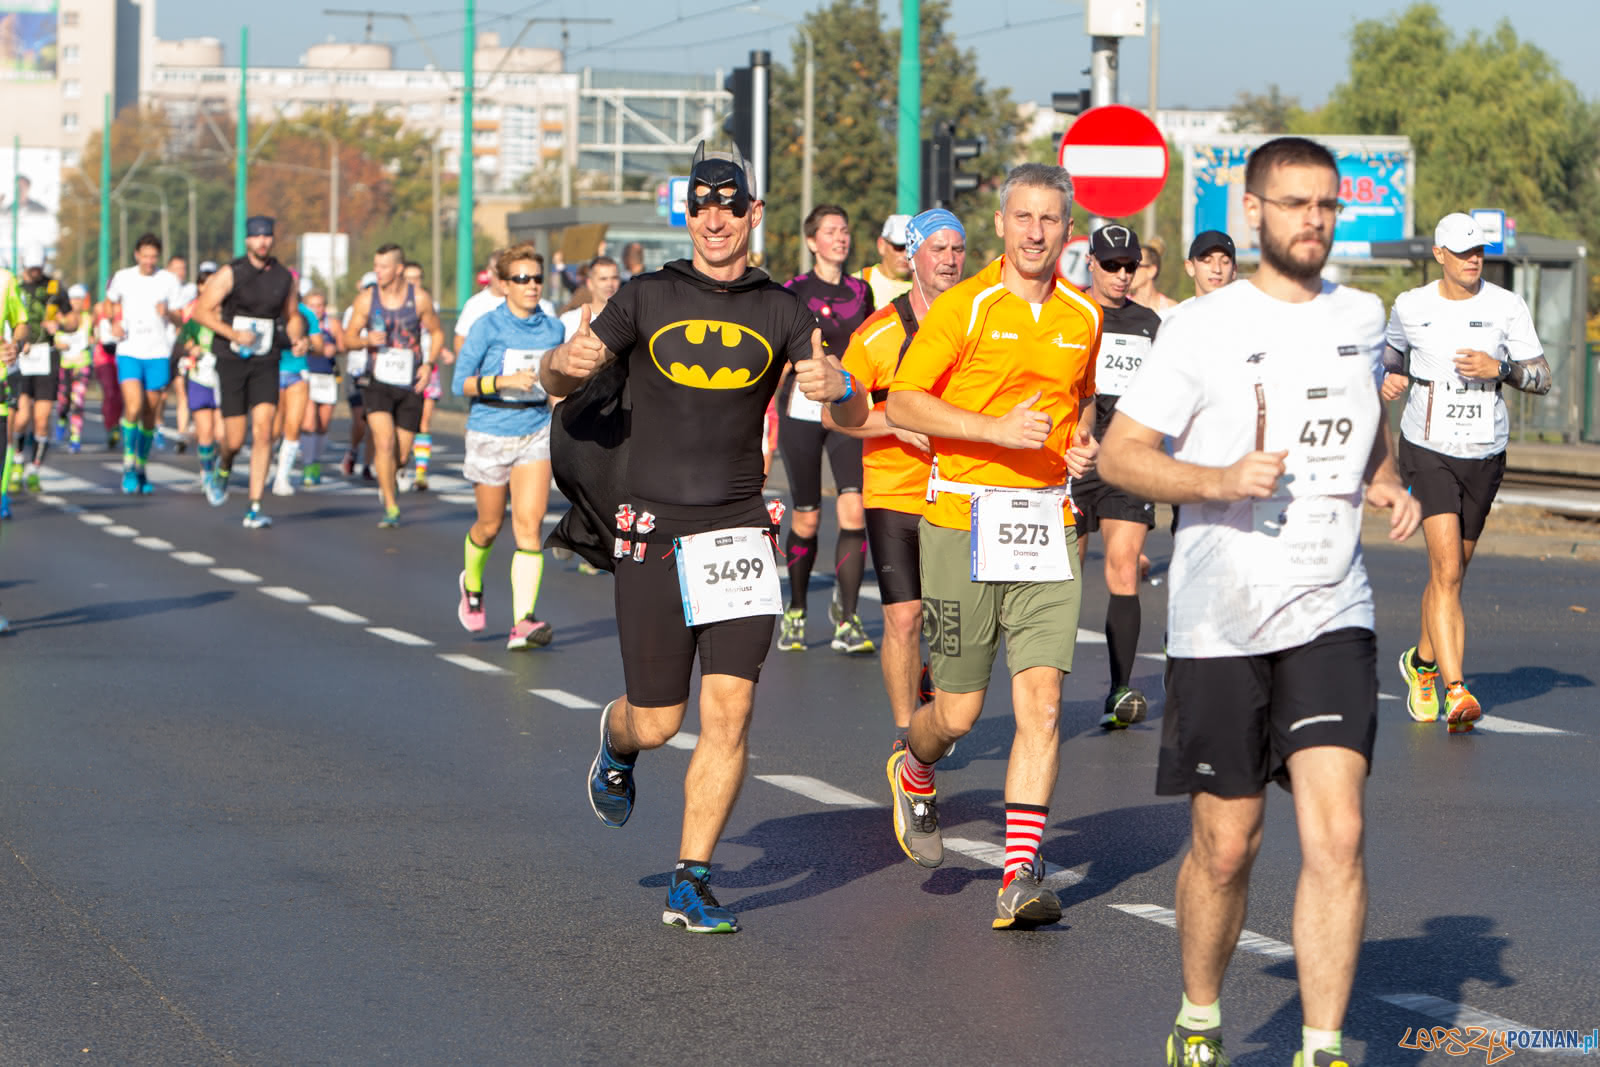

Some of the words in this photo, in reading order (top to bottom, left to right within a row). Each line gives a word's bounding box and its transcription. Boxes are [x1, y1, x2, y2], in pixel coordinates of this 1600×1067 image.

[1104, 354, 1142, 371] 2439
[1446, 404, 1482, 419] 2731
[1299, 417, 1353, 447] 479
[998, 523, 1049, 546] 5273
[703, 557, 764, 585] 3499
